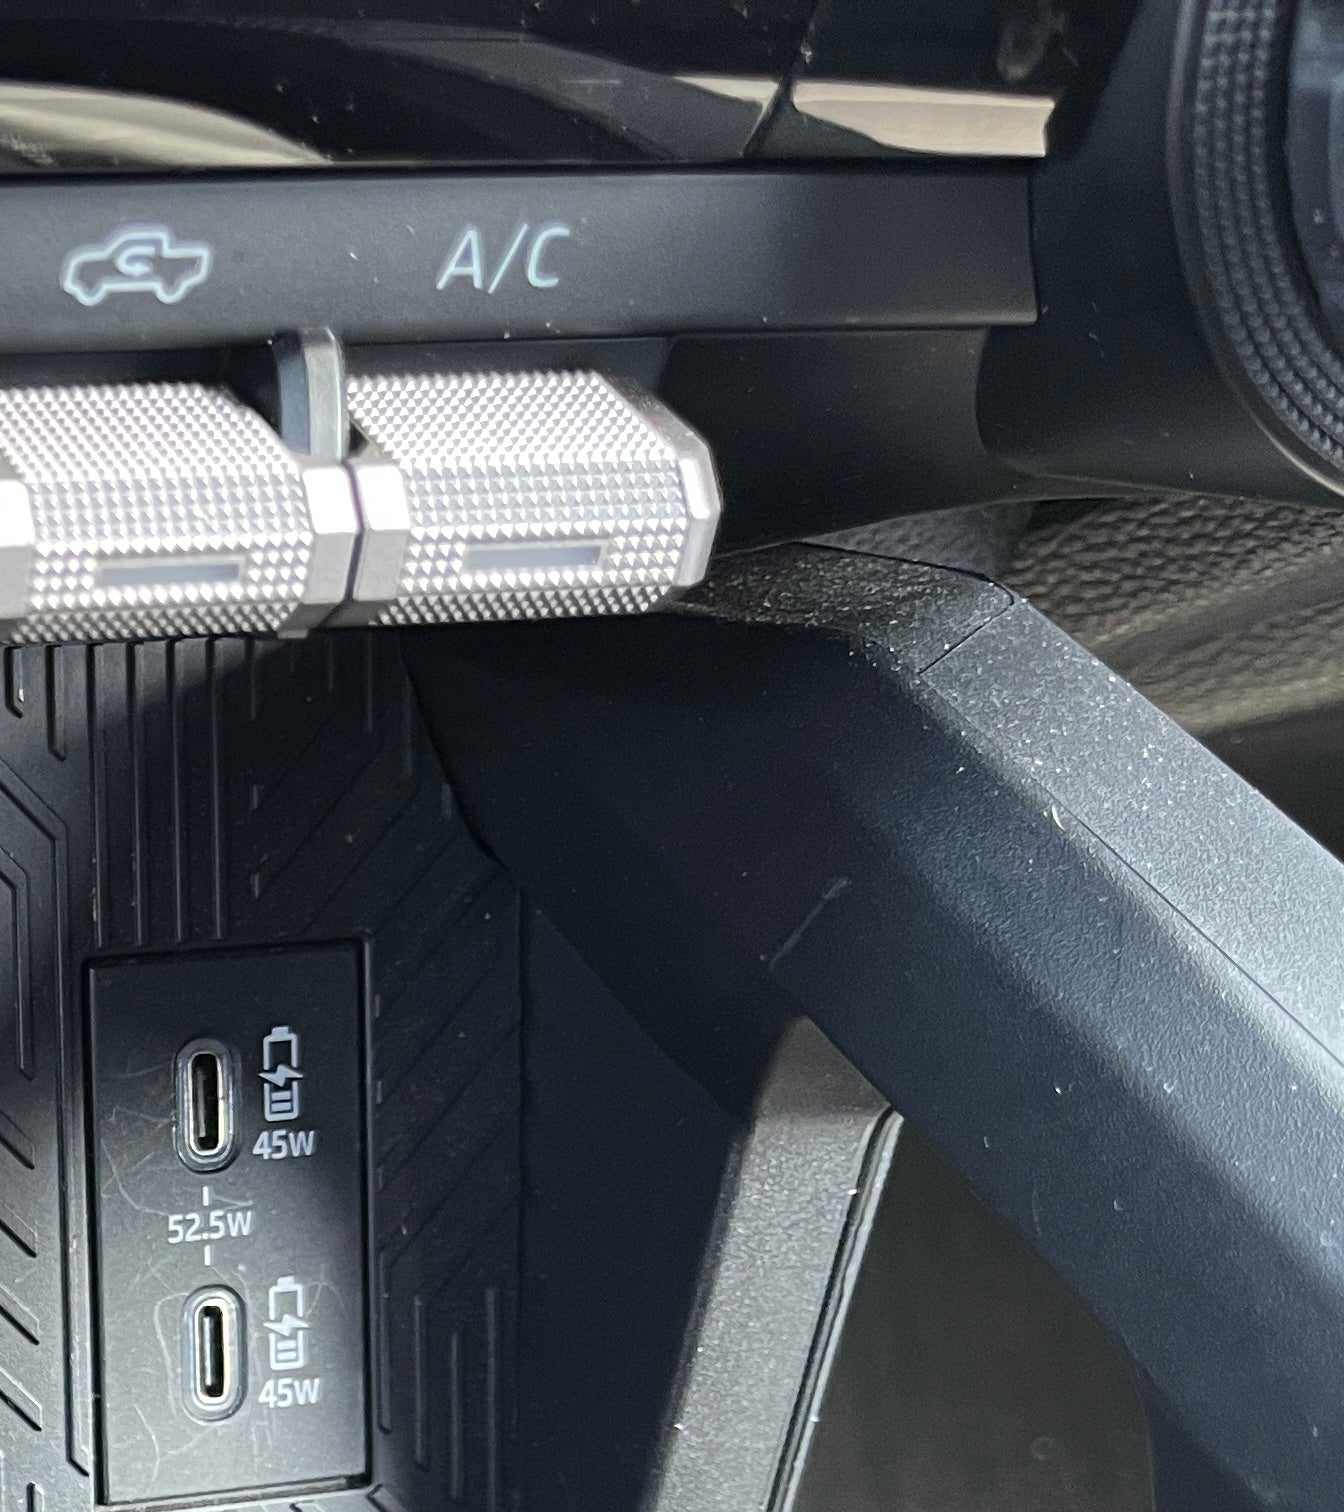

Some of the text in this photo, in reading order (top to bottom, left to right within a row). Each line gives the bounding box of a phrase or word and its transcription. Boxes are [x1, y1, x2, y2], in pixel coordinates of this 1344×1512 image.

[436, 224, 570, 294] A/C
[252, 1130, 315, 1160] 45W
[167, 1209, 253, 1245] 52.5W
[258, 1377, 321, 1409] 45W
